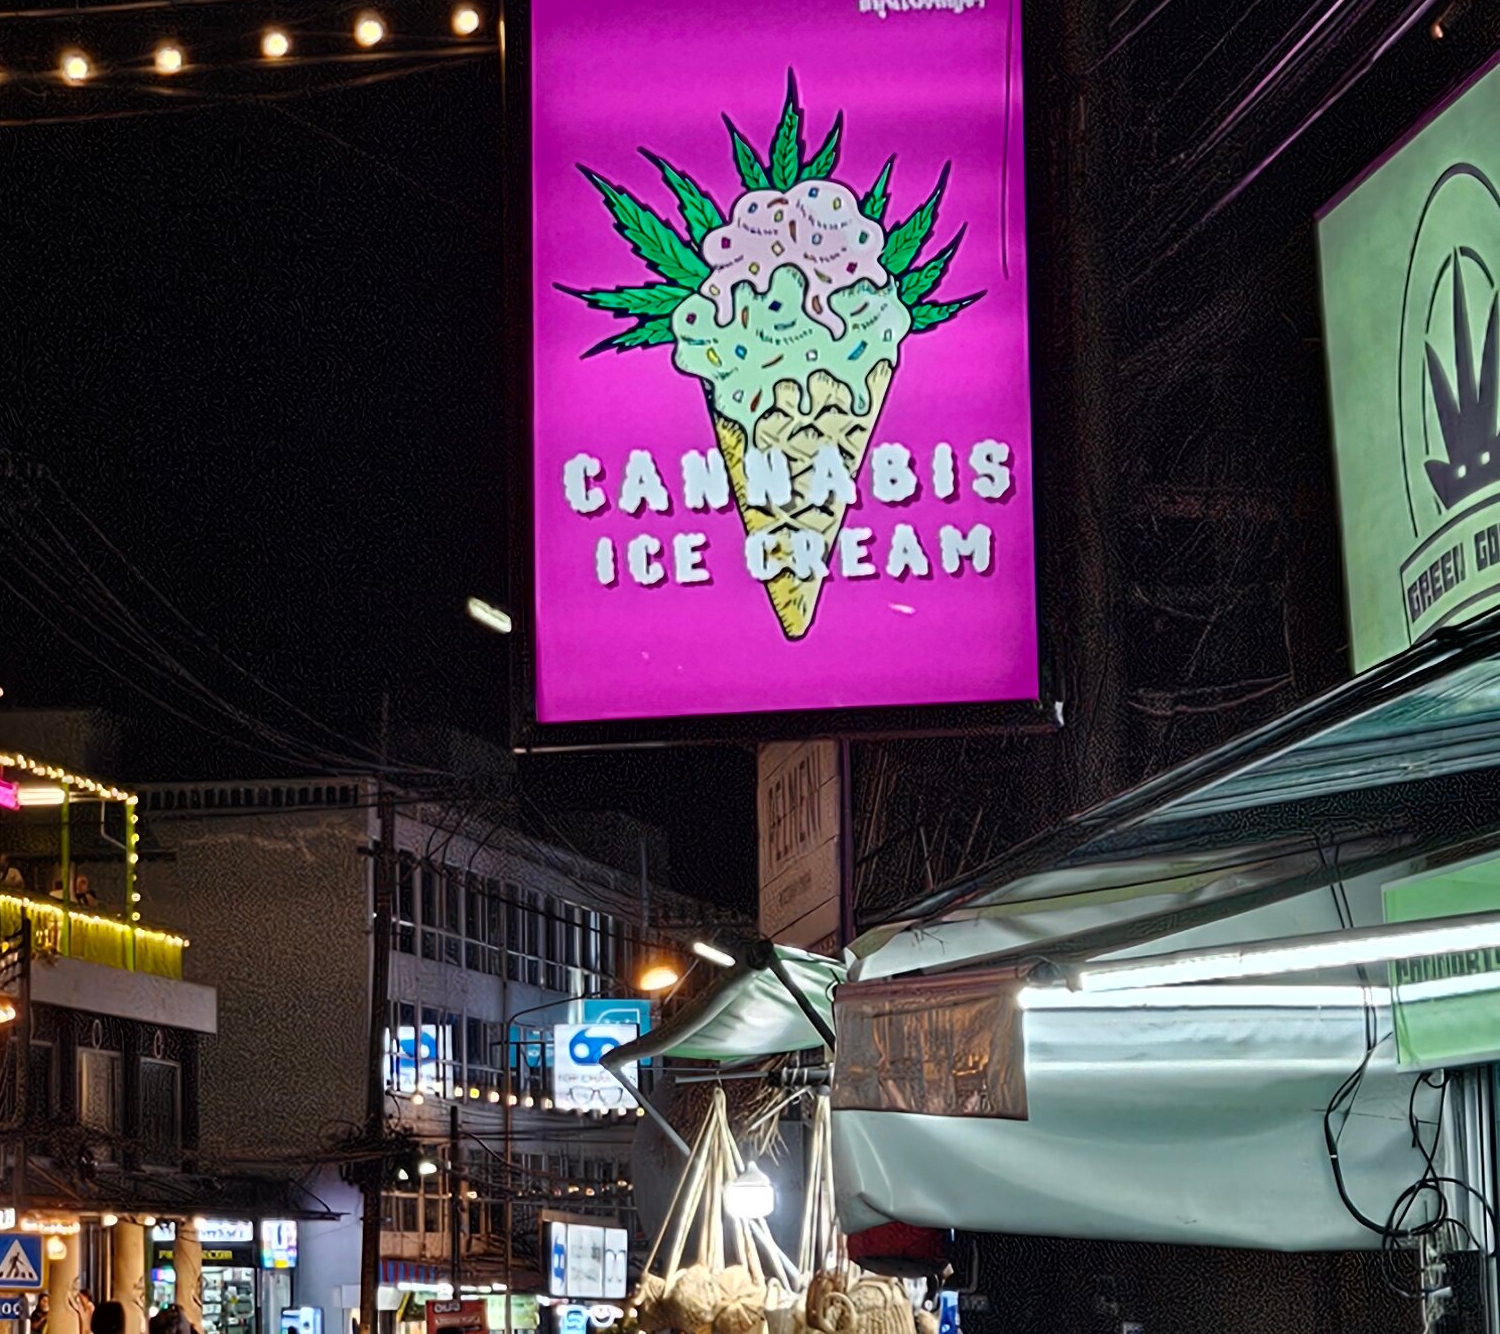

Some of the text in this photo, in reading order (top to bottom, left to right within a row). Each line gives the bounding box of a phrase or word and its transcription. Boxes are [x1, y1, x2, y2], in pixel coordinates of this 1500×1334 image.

[562, 439, 1015, 515] CANNABIS
[595, 522, 995, 586] ICE CREAM
[1407, 542, 1466, 624] GREEN
